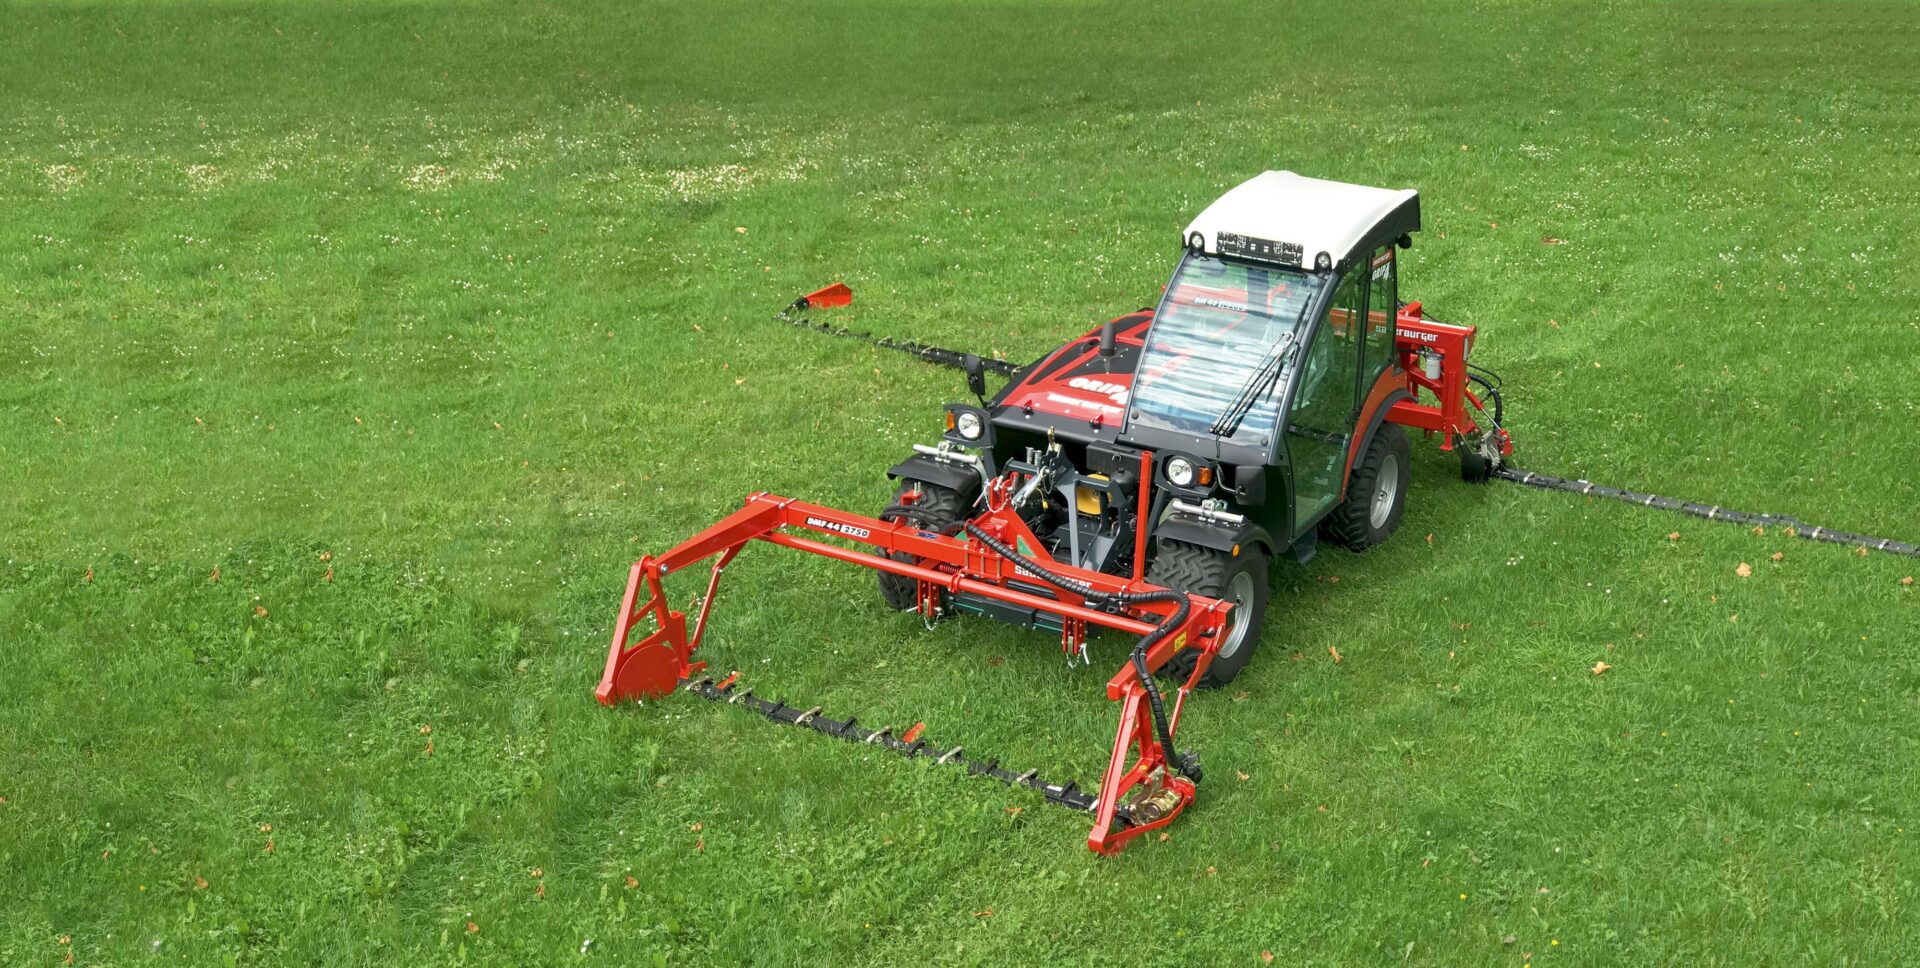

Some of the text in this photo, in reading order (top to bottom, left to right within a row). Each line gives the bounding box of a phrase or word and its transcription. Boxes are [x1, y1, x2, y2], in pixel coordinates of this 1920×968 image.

[807, 517, 868, 537] DMF 44 2750
